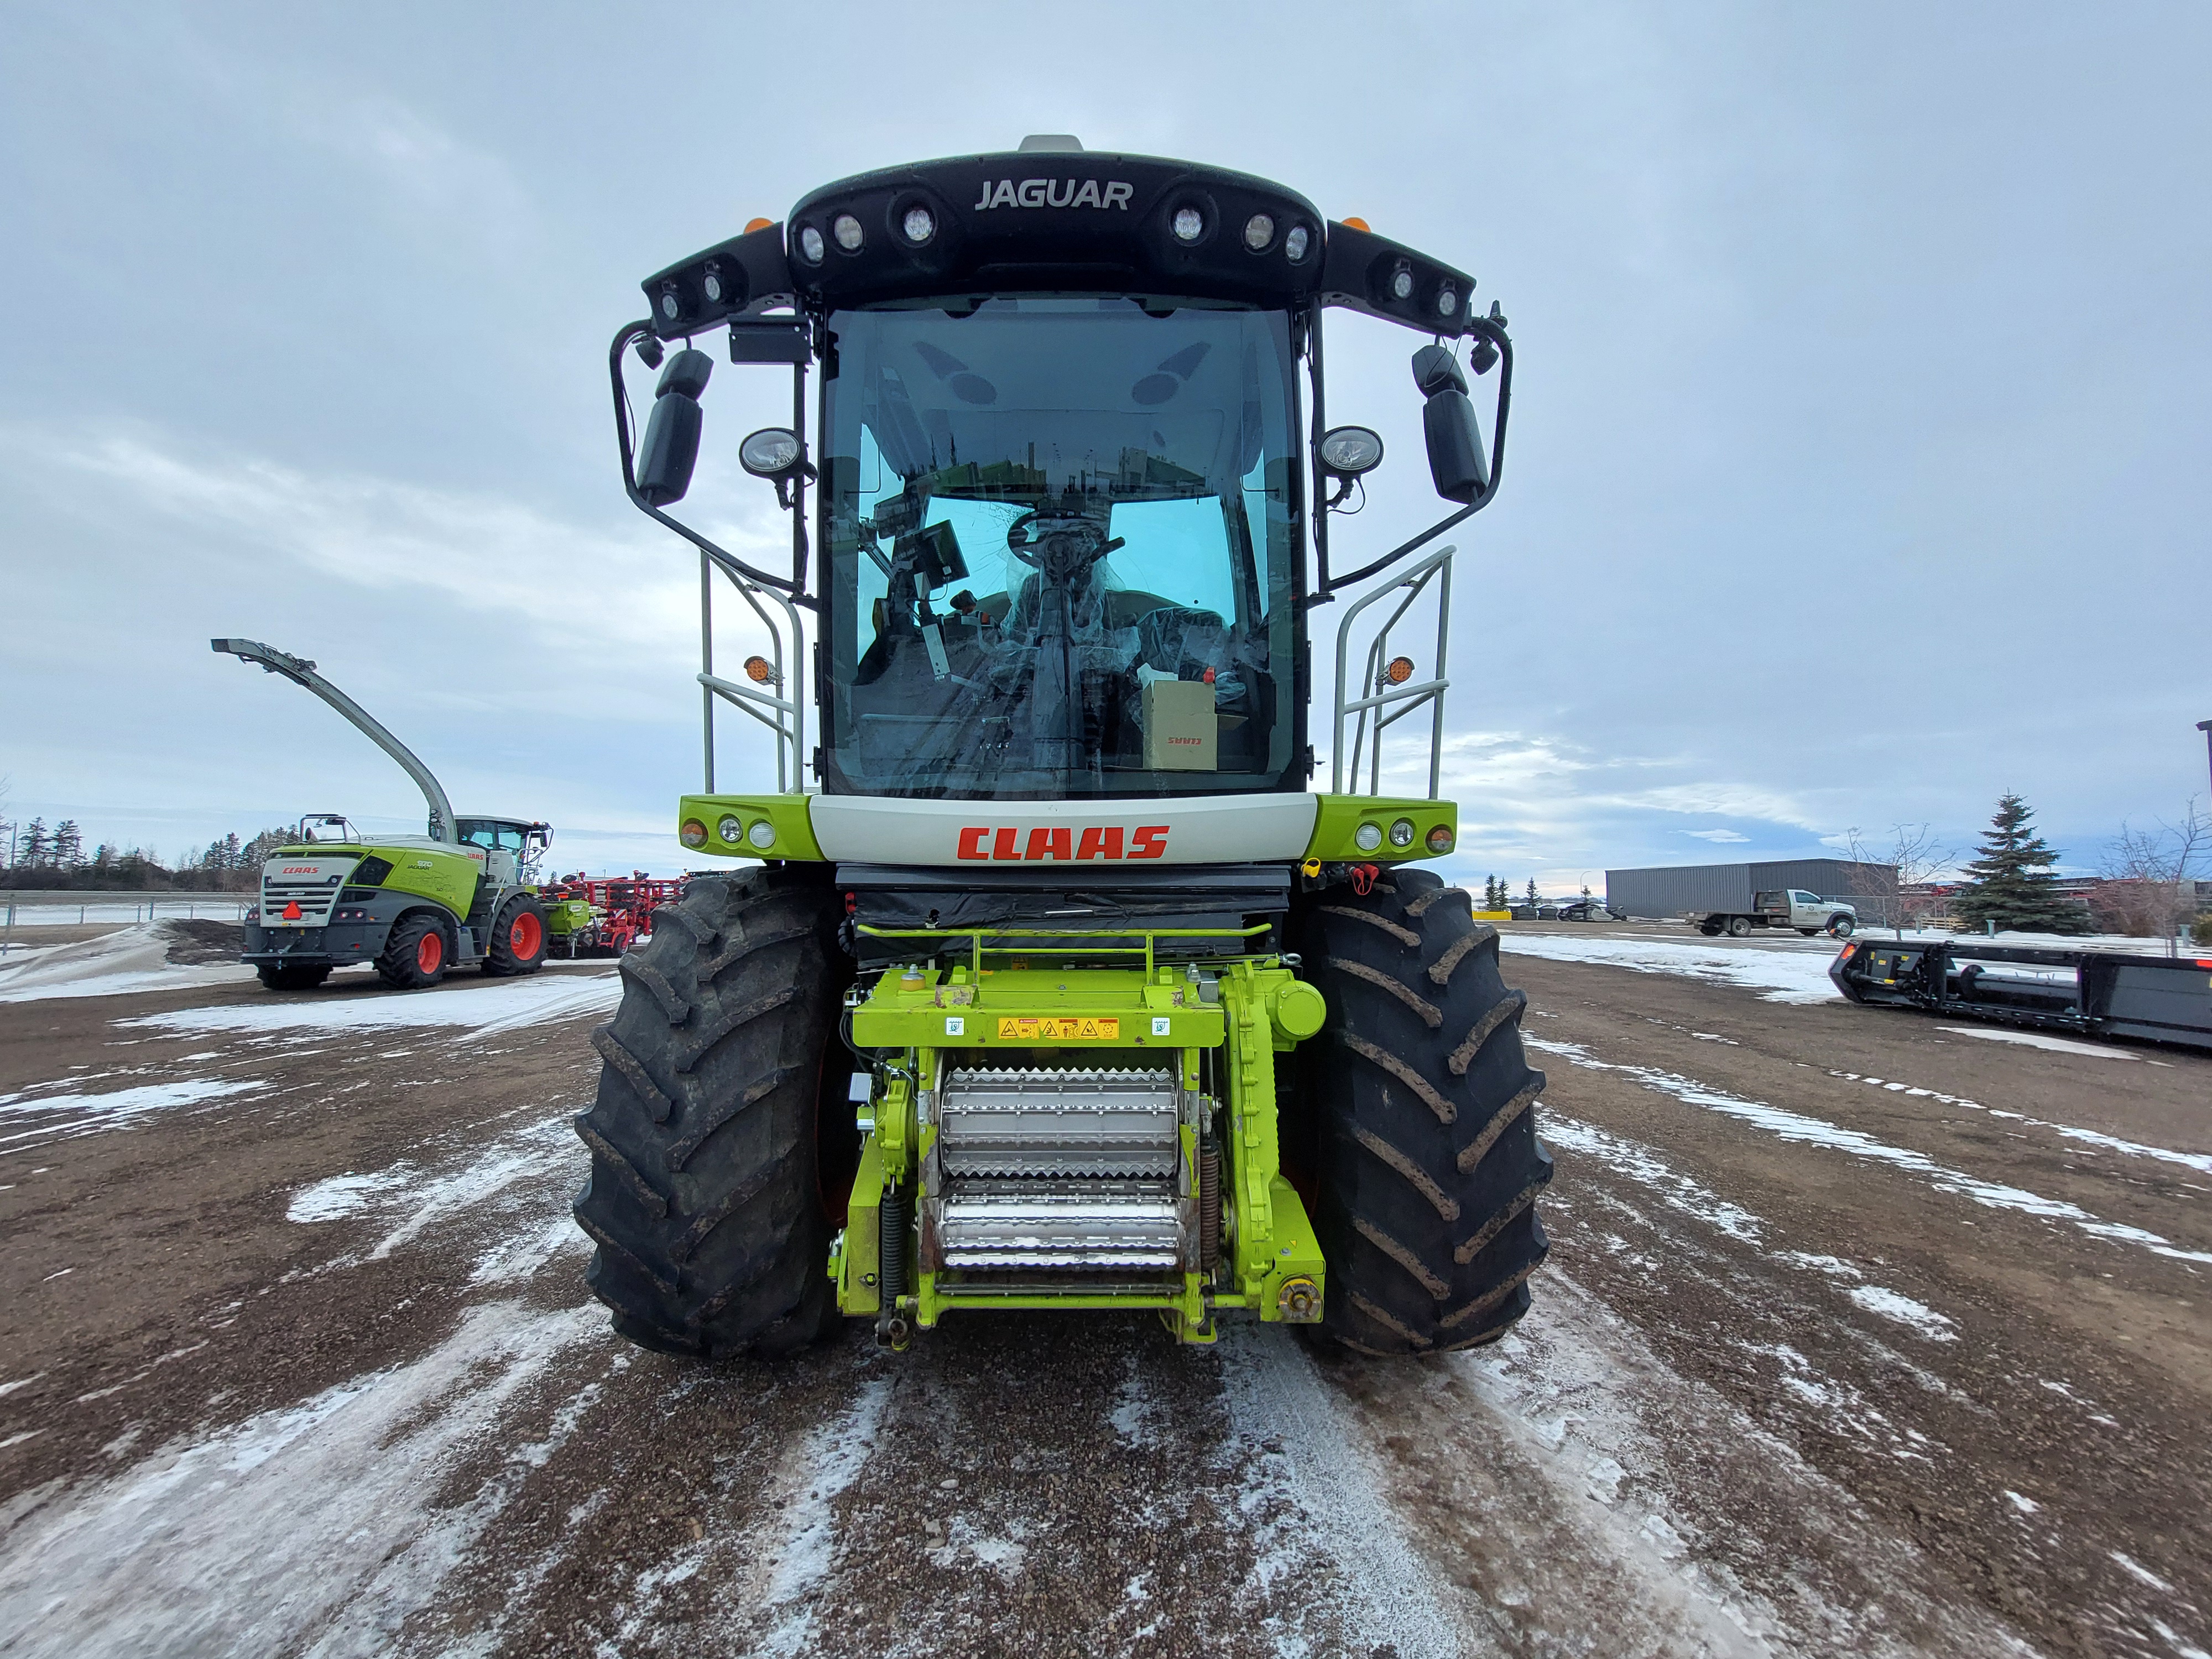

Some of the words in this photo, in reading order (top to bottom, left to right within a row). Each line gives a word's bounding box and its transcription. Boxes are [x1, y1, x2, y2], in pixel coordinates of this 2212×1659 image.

[974, 179, 1134, 211] JAGUAR
[1168, 737, 1202, 745] CLAAS
[957, 826, 1171, 860] CLAAS
